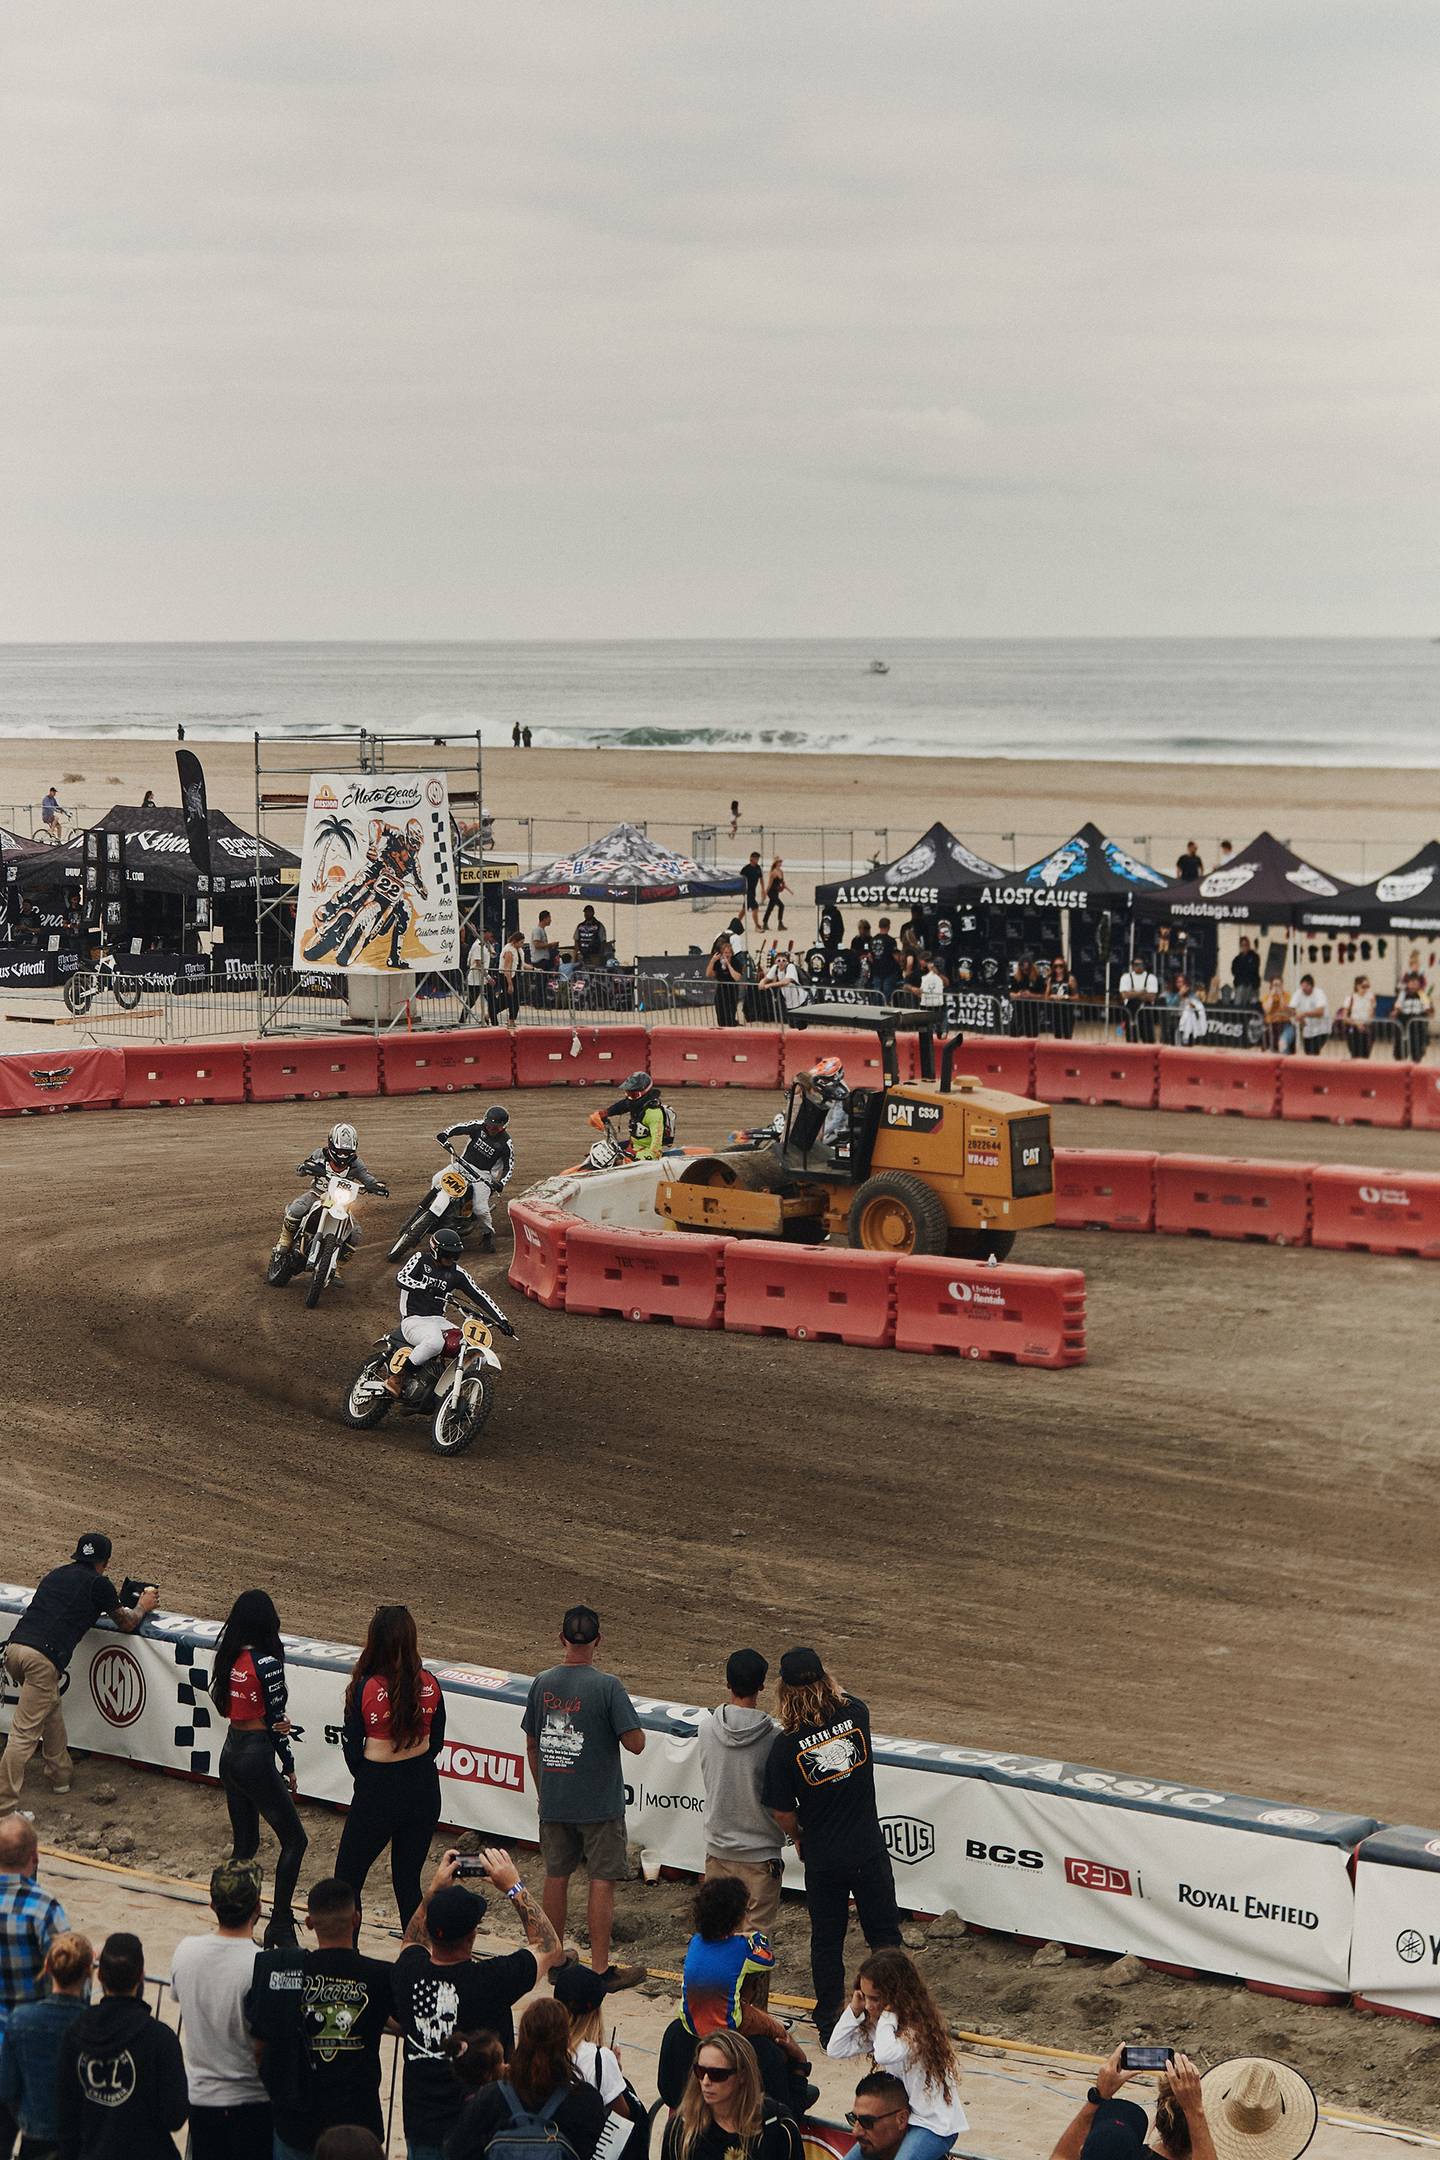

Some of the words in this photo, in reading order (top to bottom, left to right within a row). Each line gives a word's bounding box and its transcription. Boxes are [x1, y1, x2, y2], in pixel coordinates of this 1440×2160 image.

[342, 785, 383, 808] Moto
[383, 783, 422, 804] Beach
[376, 878, 400, 899] 22
[836, 886, 848, 903] A
[850, 886, 886, 903] LOST
[886, 887, 939, 904] CAUSE
[980, 887, 993, 904] A
[995, 888, 1034, 905] LOST
[1034, 889, 1088, 908] CAUSE
[1171, 902, 1250, 919] mototags.us
[946, 994, 957, 1008] A
[959, 992, 994, 1010] LOST
[946, 1009, 995, 1028] CAUSE
[888, 1103, 915, 1127] CAT
[919, 1107, 940, 1120] CS34
[475, 1137, 496, 1156] DEUS
[1023, 1147, 1040, 1166] CAT
[421, 1274, 448, 1291] DEUS
[973, 1293, 1006, 1305] Rentals
[466, 1326, 488, 1346] 11
[798, 1729, 832, 1750] DEATH
[832, 1719, 854, 1736] GRIP
[434, 1745, 520, 1787] MOTUL
[939, 1750, 1227, 1809] CLASSIC
[882, 1822, 929, 1857] DEUS
[966, 1839, 1044, 1869] BGS
[1178, 1883, 1240, 1913] ROYAL
[1244, 1895, 1319, 1931] ENFIELD
[303, 1974, 367, 2002] Vans
